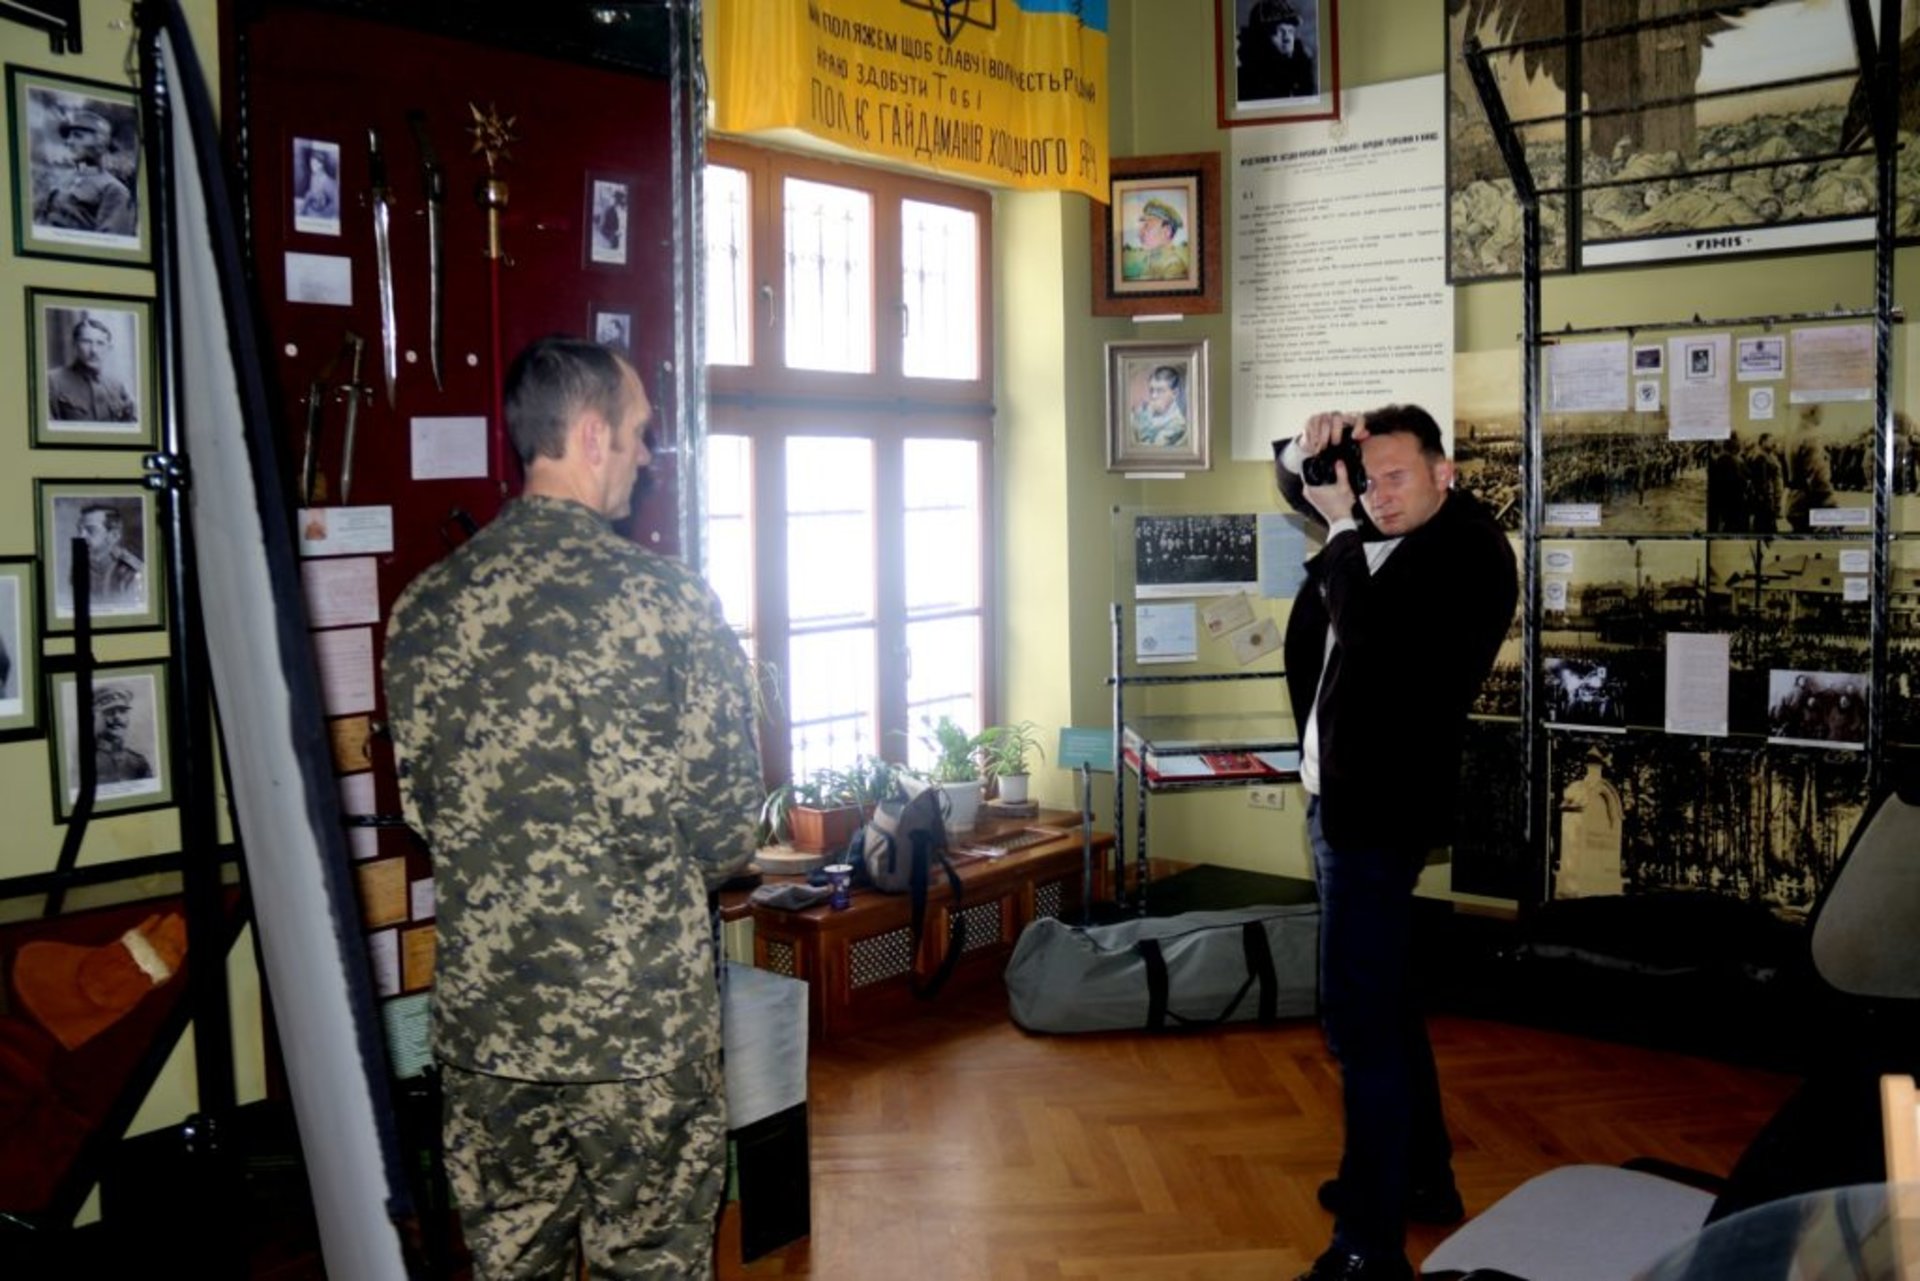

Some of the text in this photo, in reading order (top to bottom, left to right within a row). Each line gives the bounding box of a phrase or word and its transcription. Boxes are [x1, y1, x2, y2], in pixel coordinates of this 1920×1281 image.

[822, 11, 897, 53] ПОЛЯЖЕМ
[901, 33, 933, 62] ЩОБ
[938, 45, 979, 74] СЛАВУ
[856, 62, 928, 98] ЗДОБУТИ
